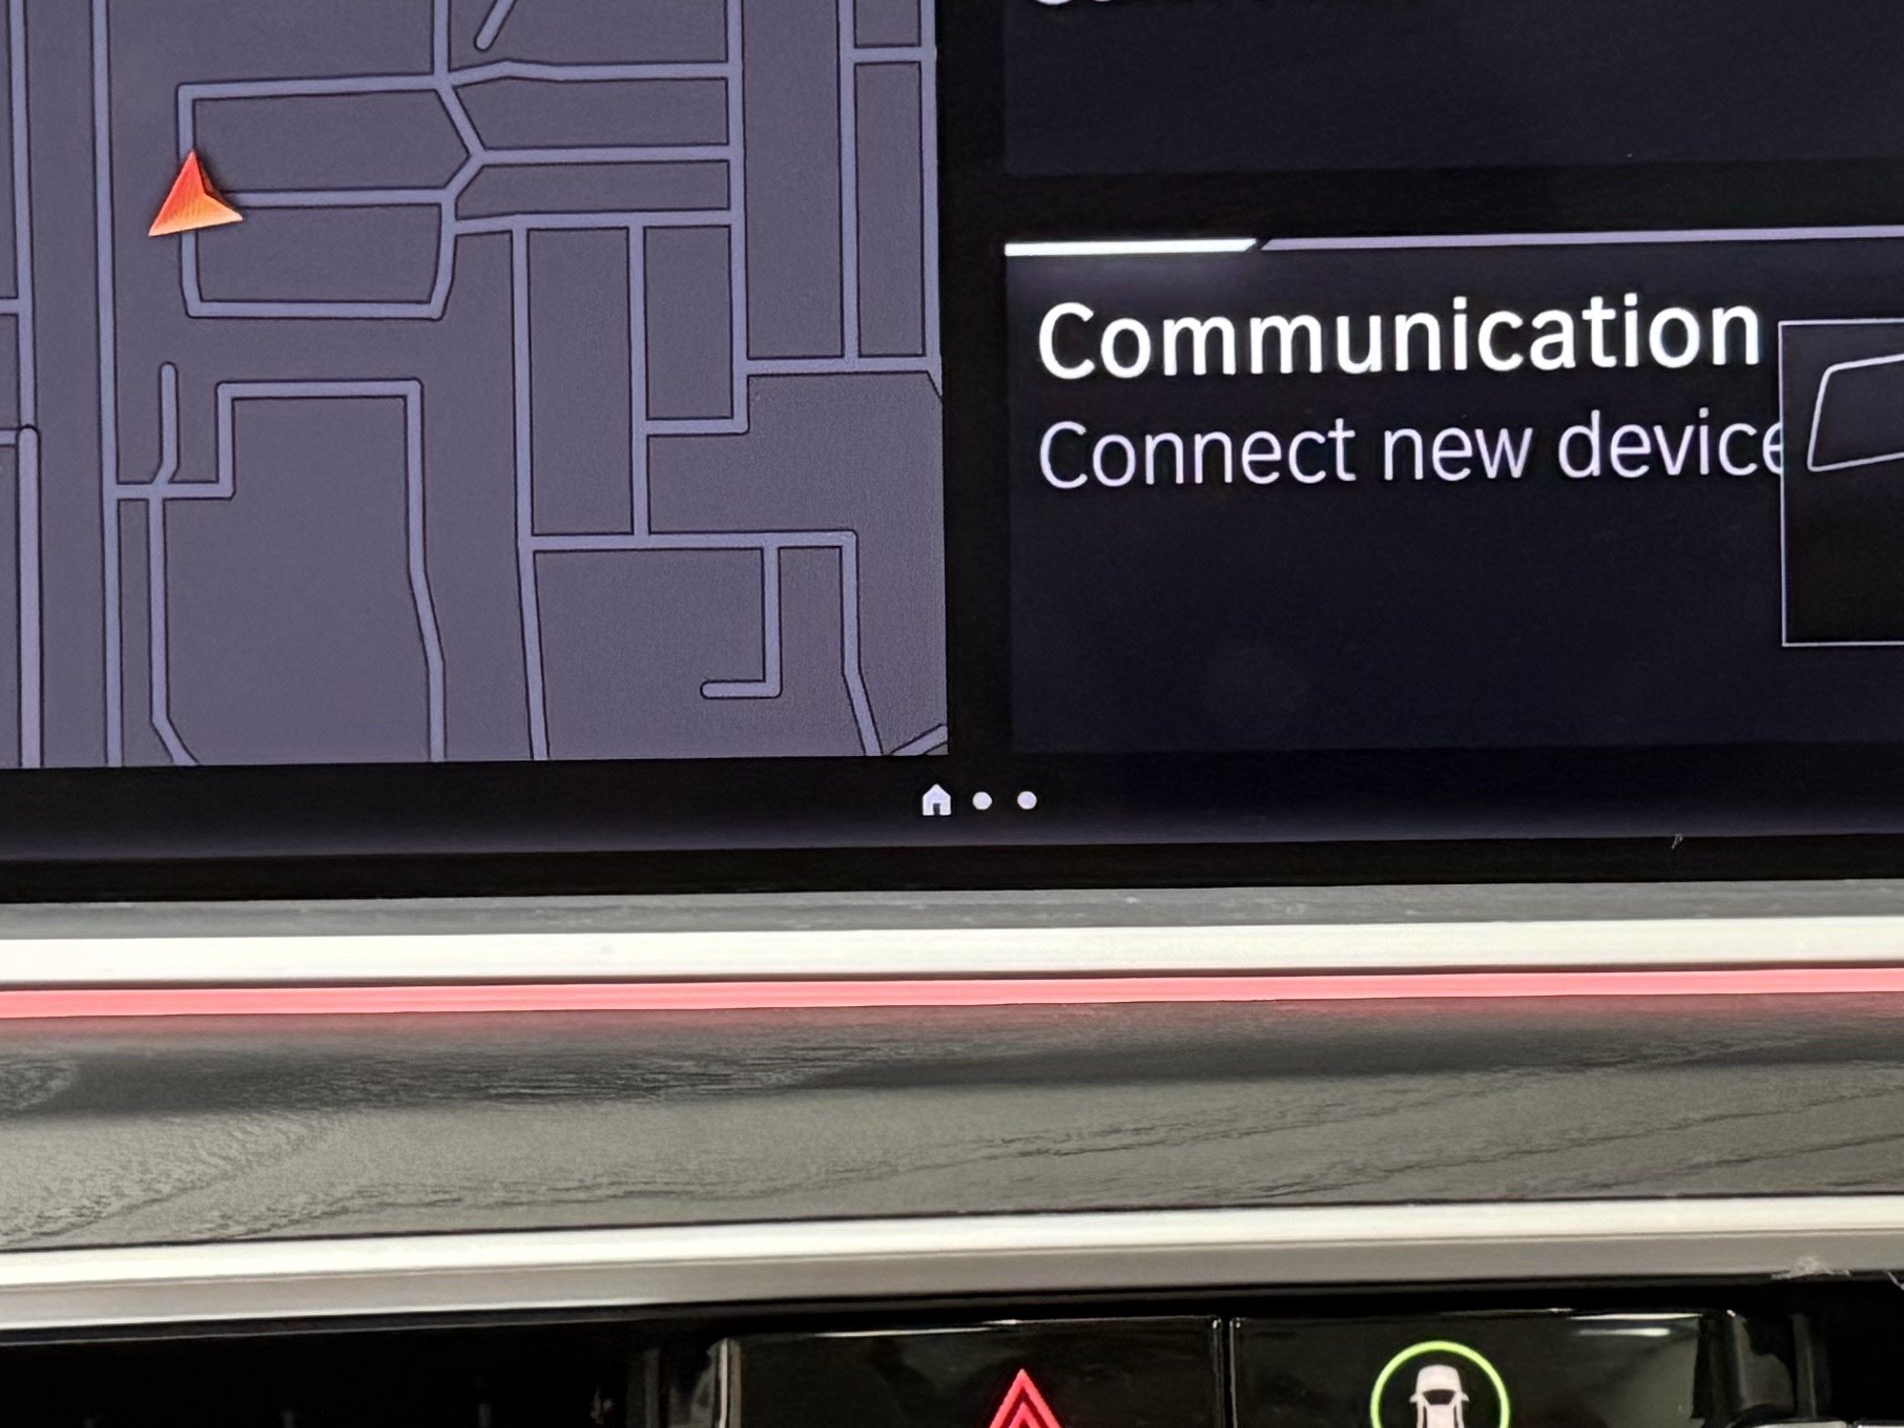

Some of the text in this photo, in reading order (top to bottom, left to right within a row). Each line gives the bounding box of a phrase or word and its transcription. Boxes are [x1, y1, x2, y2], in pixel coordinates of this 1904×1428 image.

[1039, 293, 1759, 379] Communication
[1040, 418, 1356, 488] Connect
[1385, 428, 1532, 481] new
